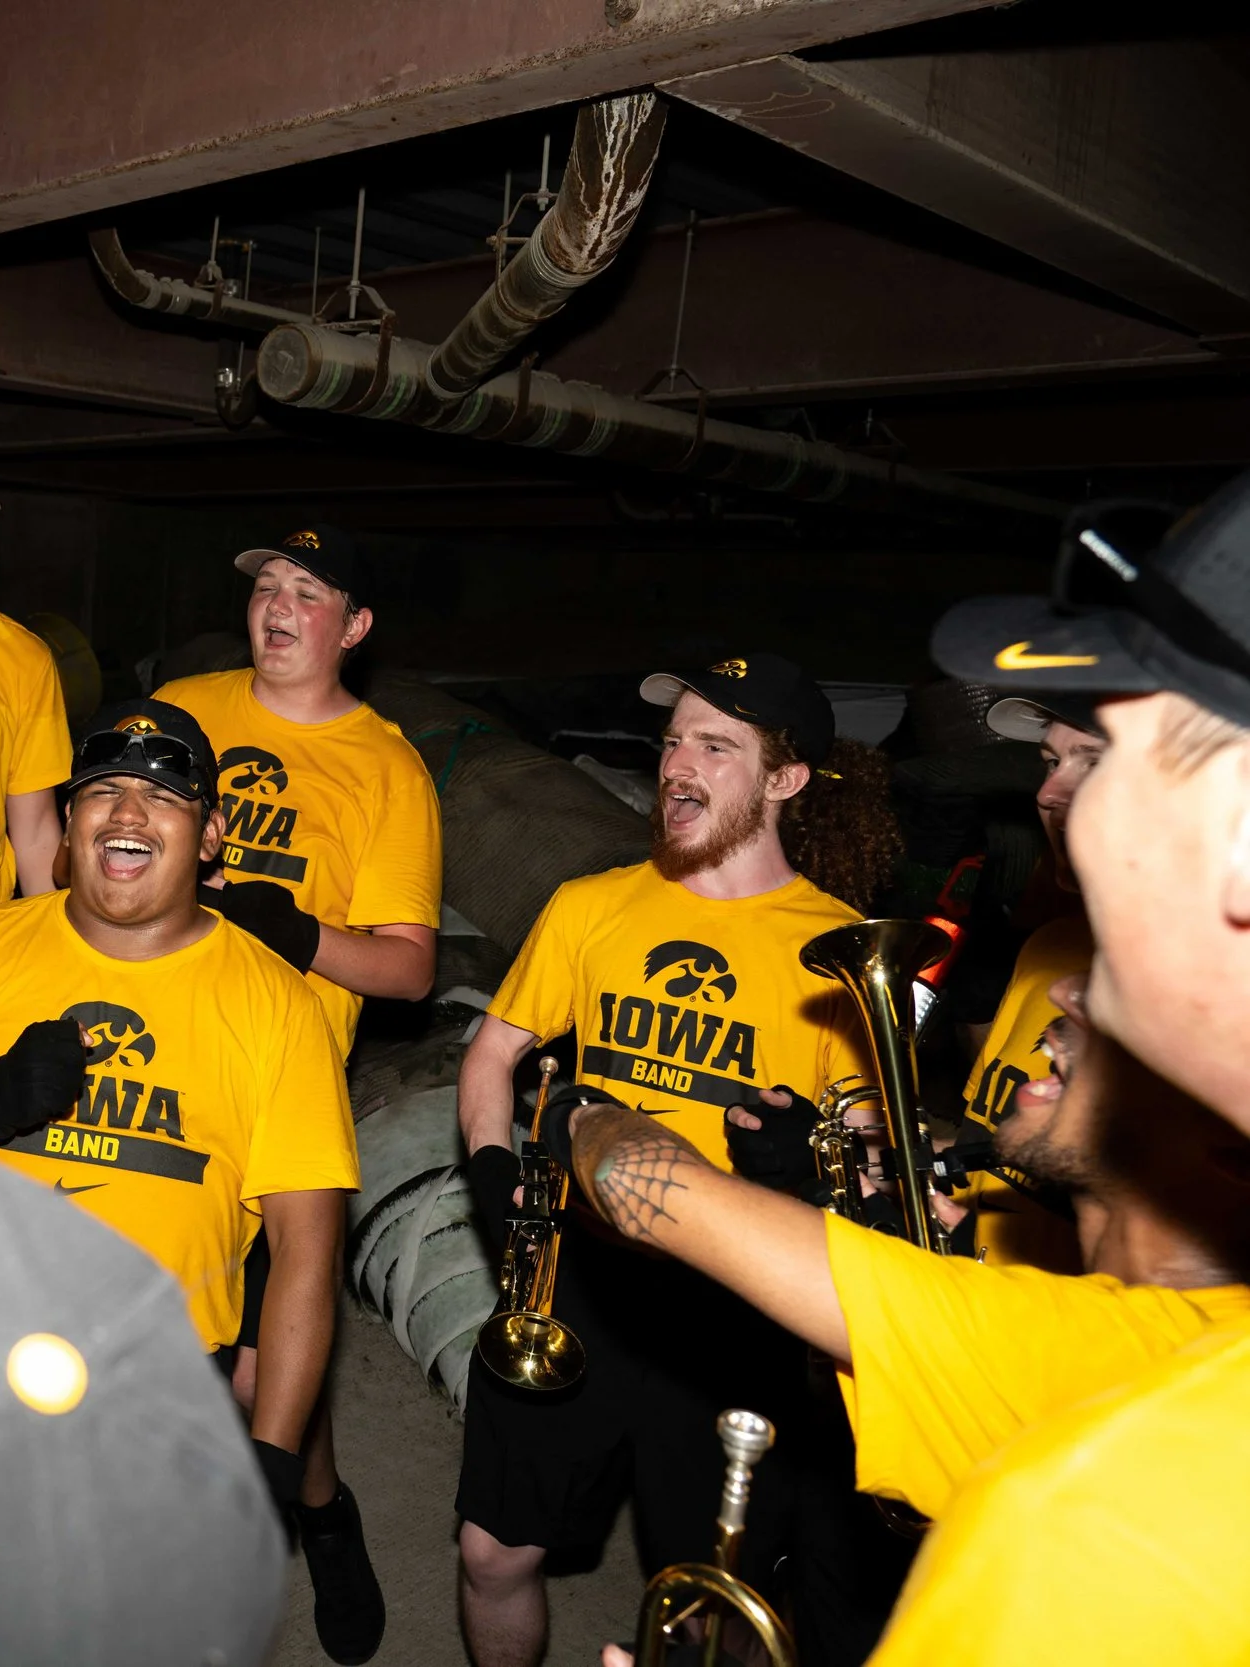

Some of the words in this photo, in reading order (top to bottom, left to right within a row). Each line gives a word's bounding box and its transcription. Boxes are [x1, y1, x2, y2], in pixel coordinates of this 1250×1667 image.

[599, 992, 756, 1079] IOWA
[77, 1073, 185, 1142] WA
[631, 1059, 693, 1093] BAND
[970, 1057, 1031, 1124] IO
[45, 1127, 119, 1162] BAND
